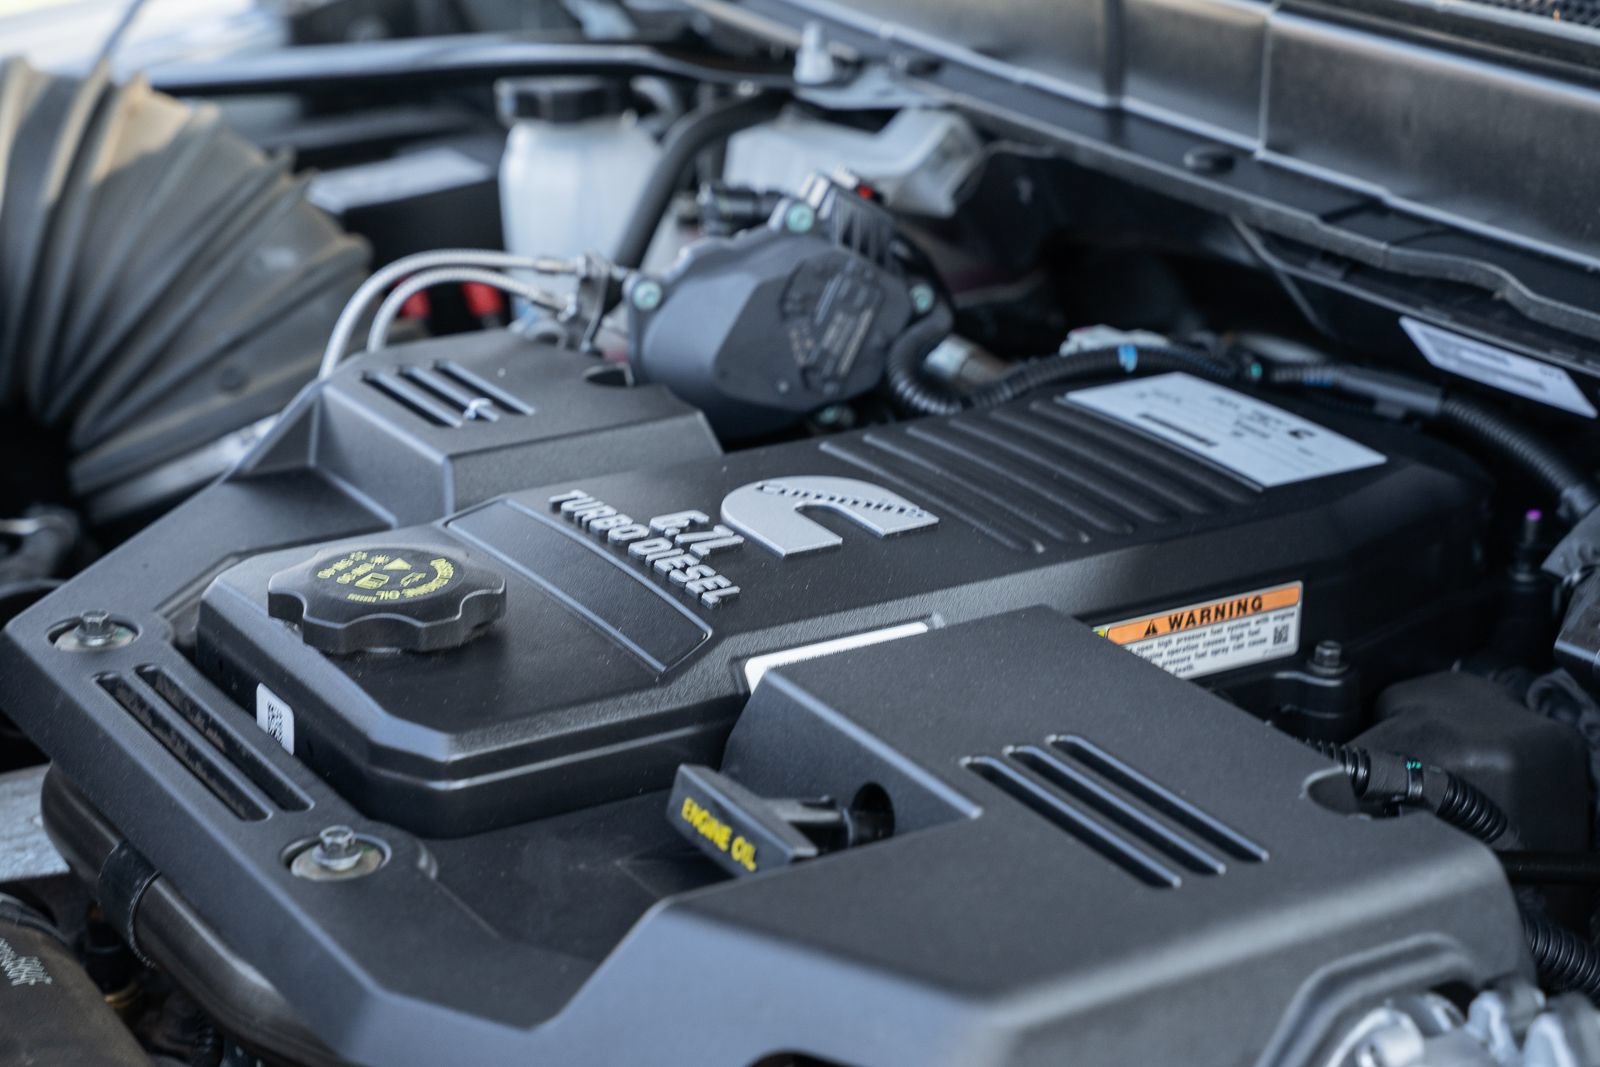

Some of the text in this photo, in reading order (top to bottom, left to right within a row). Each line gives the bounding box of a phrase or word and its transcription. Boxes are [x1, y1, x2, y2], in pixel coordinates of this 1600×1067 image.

[549, 489, 741, 609] TURBO DIESEL
[650, 509, 745, 557] 6.7L
[1168, 595, 1263, 632] WARNING
[1157, 638, 1172, 649] high
[1176, 631, 1206, 644] pressure
[1210, 625, 1223, 635] fuel
[1229, 631, 1244, 642] high
[1248, 627, 1260, 636] fuel
[1194, 650, 1206, 659] fuel
[681, 797, 757, 871] ENGINE OIL
